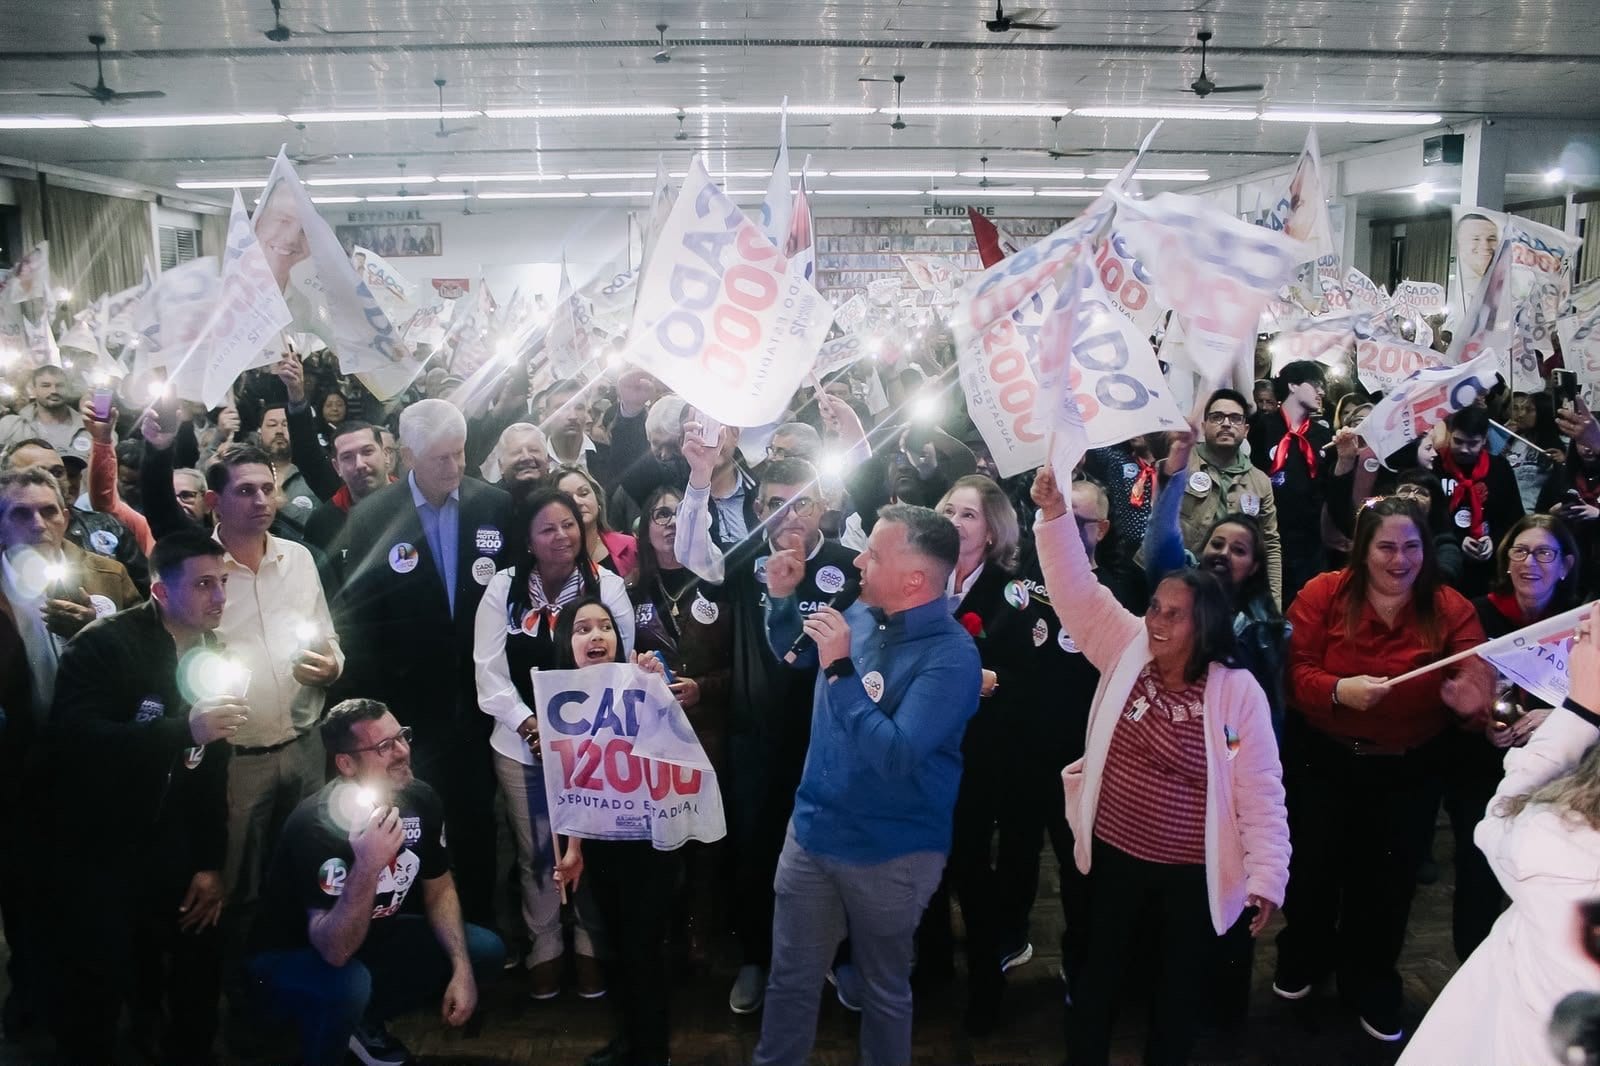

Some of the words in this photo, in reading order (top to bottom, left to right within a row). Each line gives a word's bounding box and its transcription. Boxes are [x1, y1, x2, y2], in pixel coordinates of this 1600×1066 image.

[924, 206, 995, 216] ENTIDDE
[476, 540, 501, 548] 1200
[323, 865, 347, 888] 12
